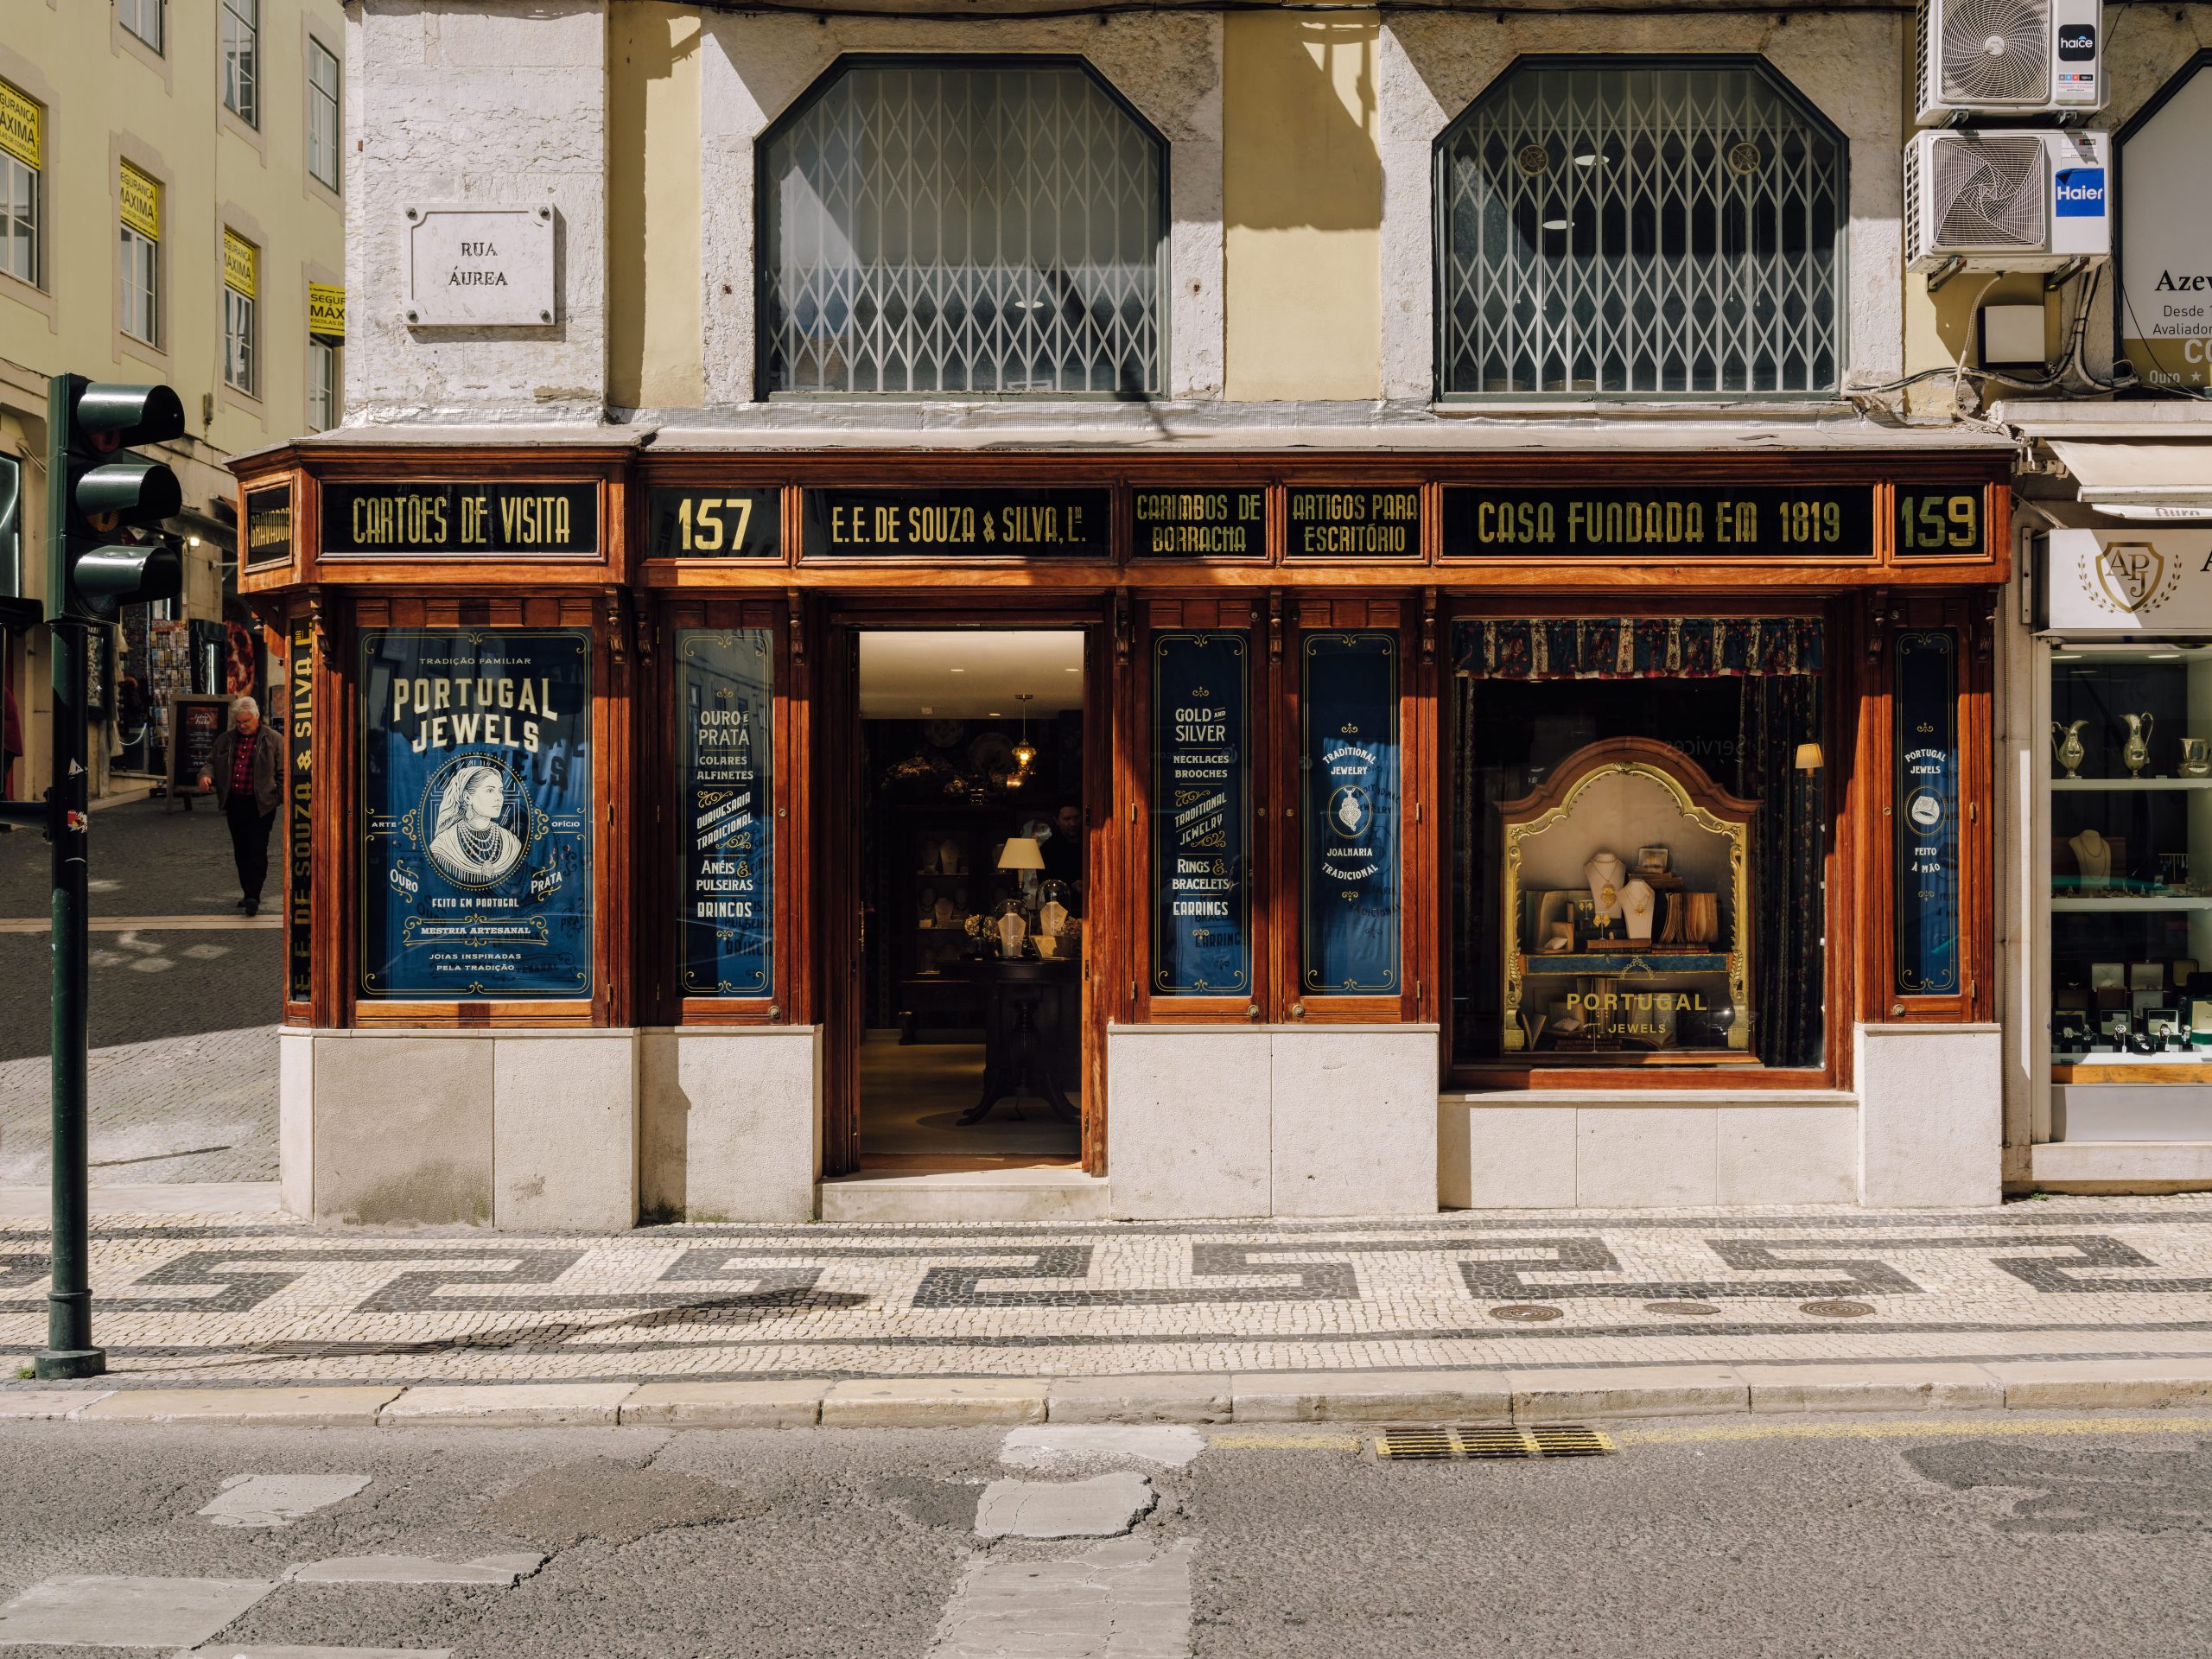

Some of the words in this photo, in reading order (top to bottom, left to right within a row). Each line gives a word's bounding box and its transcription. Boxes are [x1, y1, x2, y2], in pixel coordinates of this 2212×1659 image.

[2057, 185, 2103, 200] Haier
[461, 242, 498, 257] RUA
[448, 265, 508, 286] ÁUREA
[2164, 305, 2204, 317] Desde
[2149, 370, 2180, 384] Ouro
[1137, 494, 1228, 521] CARIMBOS
[1239, 494, 1262, 521] DE
[1292, 494, 1365, 521] ARTIGOS
[1372, 494, 1419, 521] PARA
[353, 494, 447, 543] CARTÕES
[461, 497, 487, 543] DE
[500, 497, 570, 543] VISITA
[678, 498, 753, 550] 157
[875, 506, 900, 543] DE
[909, 506, 976, 543] SOUZA
[982, 510, 995, 543] &
[1478, 501, 1556, 543] CASA
[1567, 501, 1705, 543] FUNDADA
[1715, 501, 1758, 543] EM
[1779, 501, 1841, 543] 1819
[1901, 496, 1977, 548] 159
[1152, 525, 1247, 553] BORRACHA
[1304, 523, 1406, 552] ESCRITÓRIO
[419, 657, 475, 666] TRADIÇÃO
[393, 677, 558, 722] PORTUGAL
[700, 710, 741, 725] OURO
[1175, 708, 1211, 722] GOLD
[1214, 710, 1226, 719] AND
[412, 712, 539, 753] JEWELS
[698, 728, 750, 746] PRATA
[1175, 725, 1225, 742] SILVER
[296, 748, 312, 772] &
[699, 756, 747, 766] COLARES
[1173, 755, 1230, 764] NECKLACES
[1322, 747, 1377, 765] TRADITIONAL
[1904, 748, 1947, 763] PORTUGAL
[696, 771, 753, 780] ALFINETES
[1175, 770, 1228, 779] BROOCHES
[1331, 766, 1367, 775] JEWELRY
[1910, 766, 1941, 774] JEWELS
[696, 791, 751, 830] OURIVESARIA
[1174, 791, 1227, 828] TRADITIONAL
[295, 781, 312, 877] SOUZA
[696, 811, 753, 850] TRADICIONAL
[1179, 813, 1223, 846] JEWELRY
[1327, 848, 1373, 856] JOALHARIA
[1915, 847, 1937, 856] FEITO
[736, 861, 752, 877] &
[1212, 858, 1227, 875] &
[1321, 862, 1378, 880] TRADICIONAL
[1922, 863, 1941, 874] MÃO
[531, 871, 563, 894] PRATA
[696, 880, 753, 891] PULSEIRAS
[1173, 878, 1230, 890] BRACELETS
[295, 889, 312, 925] DE
[432, 898, 456, 908] FEITO
[460, 898, 472, 908] EM
[476, 898, 519, 908] PORTUGAL
[697, 901, 752, 918] BRINCOS
[1173, 901, 1229, 916] EARRINGS
[465, 963, 515, 972] TRADIÇÃO
[1567, 993, 1707, 1011] PORTUGAL
[1608, 1023, 1667, 1033] JEWELS
